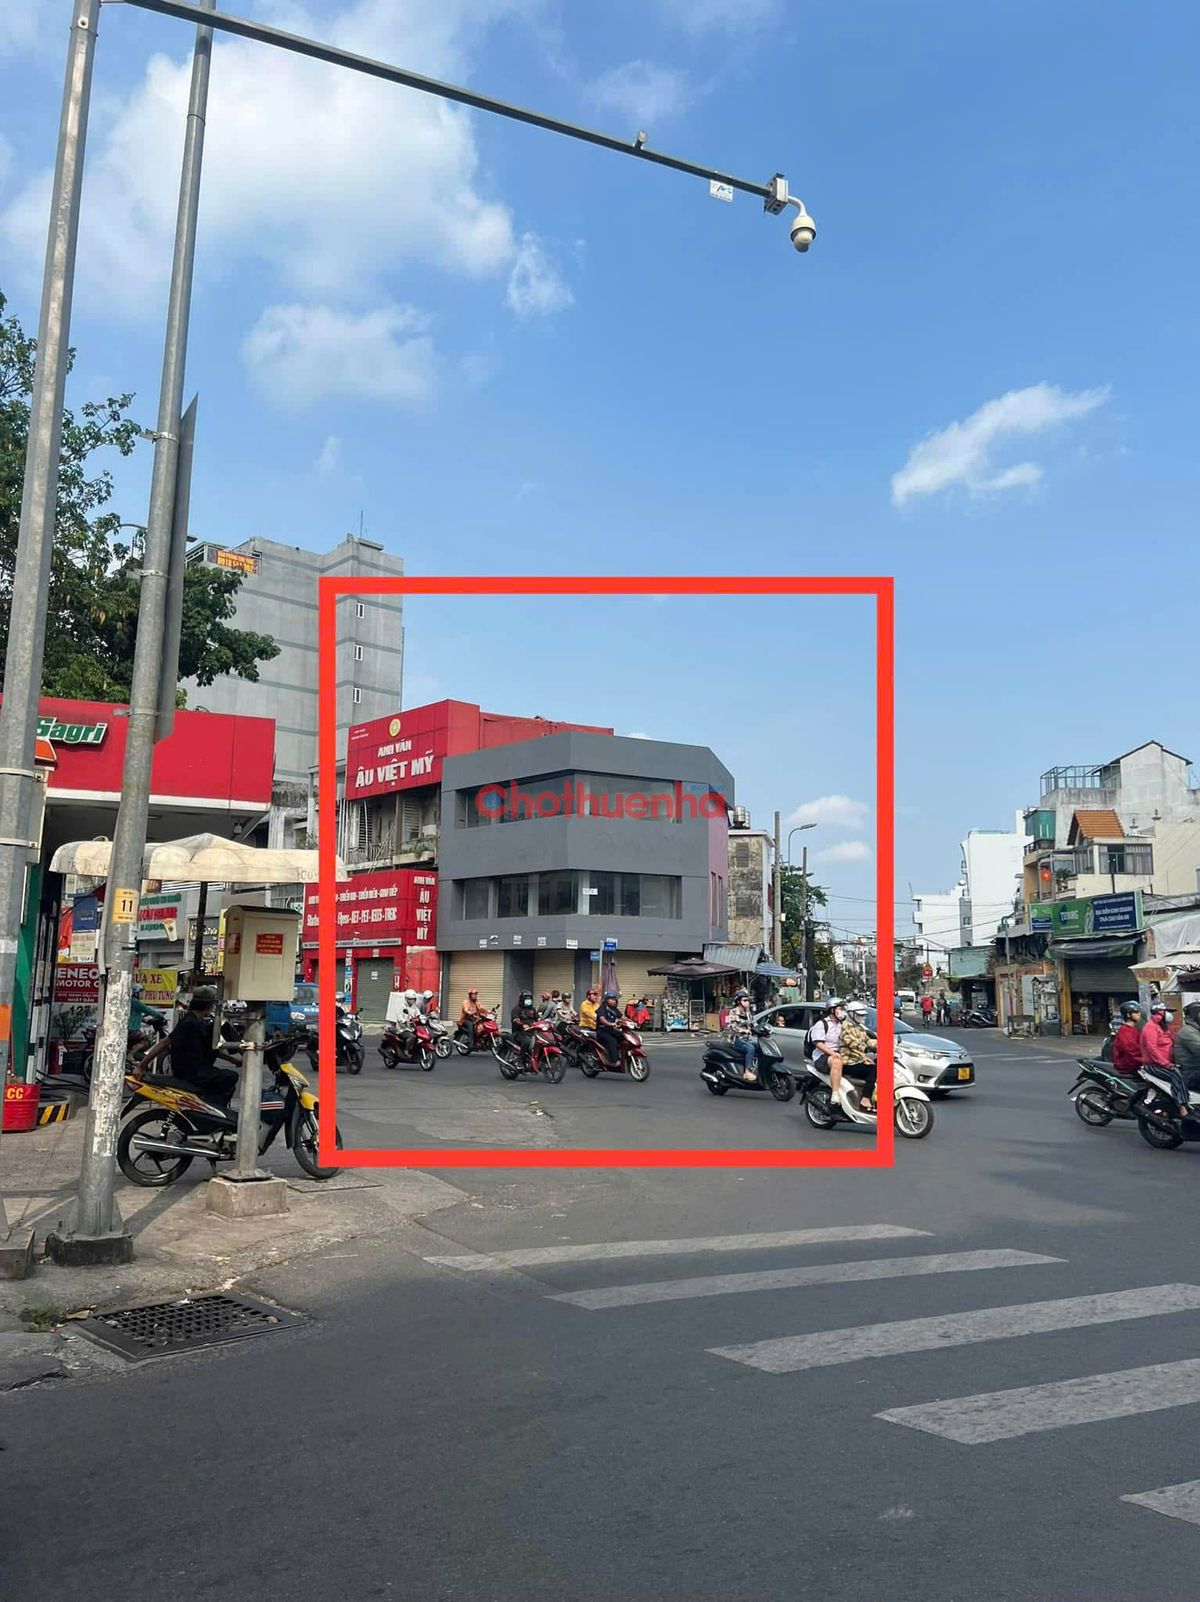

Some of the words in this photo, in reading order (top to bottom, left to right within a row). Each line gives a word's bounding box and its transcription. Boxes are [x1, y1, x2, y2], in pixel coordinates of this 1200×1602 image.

[355, 766, 374, 788] ÂU
[377, 758, 408, 786] VIỆT
[411, 749, 434, 776] MỸ
[121, 899, 133, 912] 11
[56, 980, 91, 988] MOTOR
